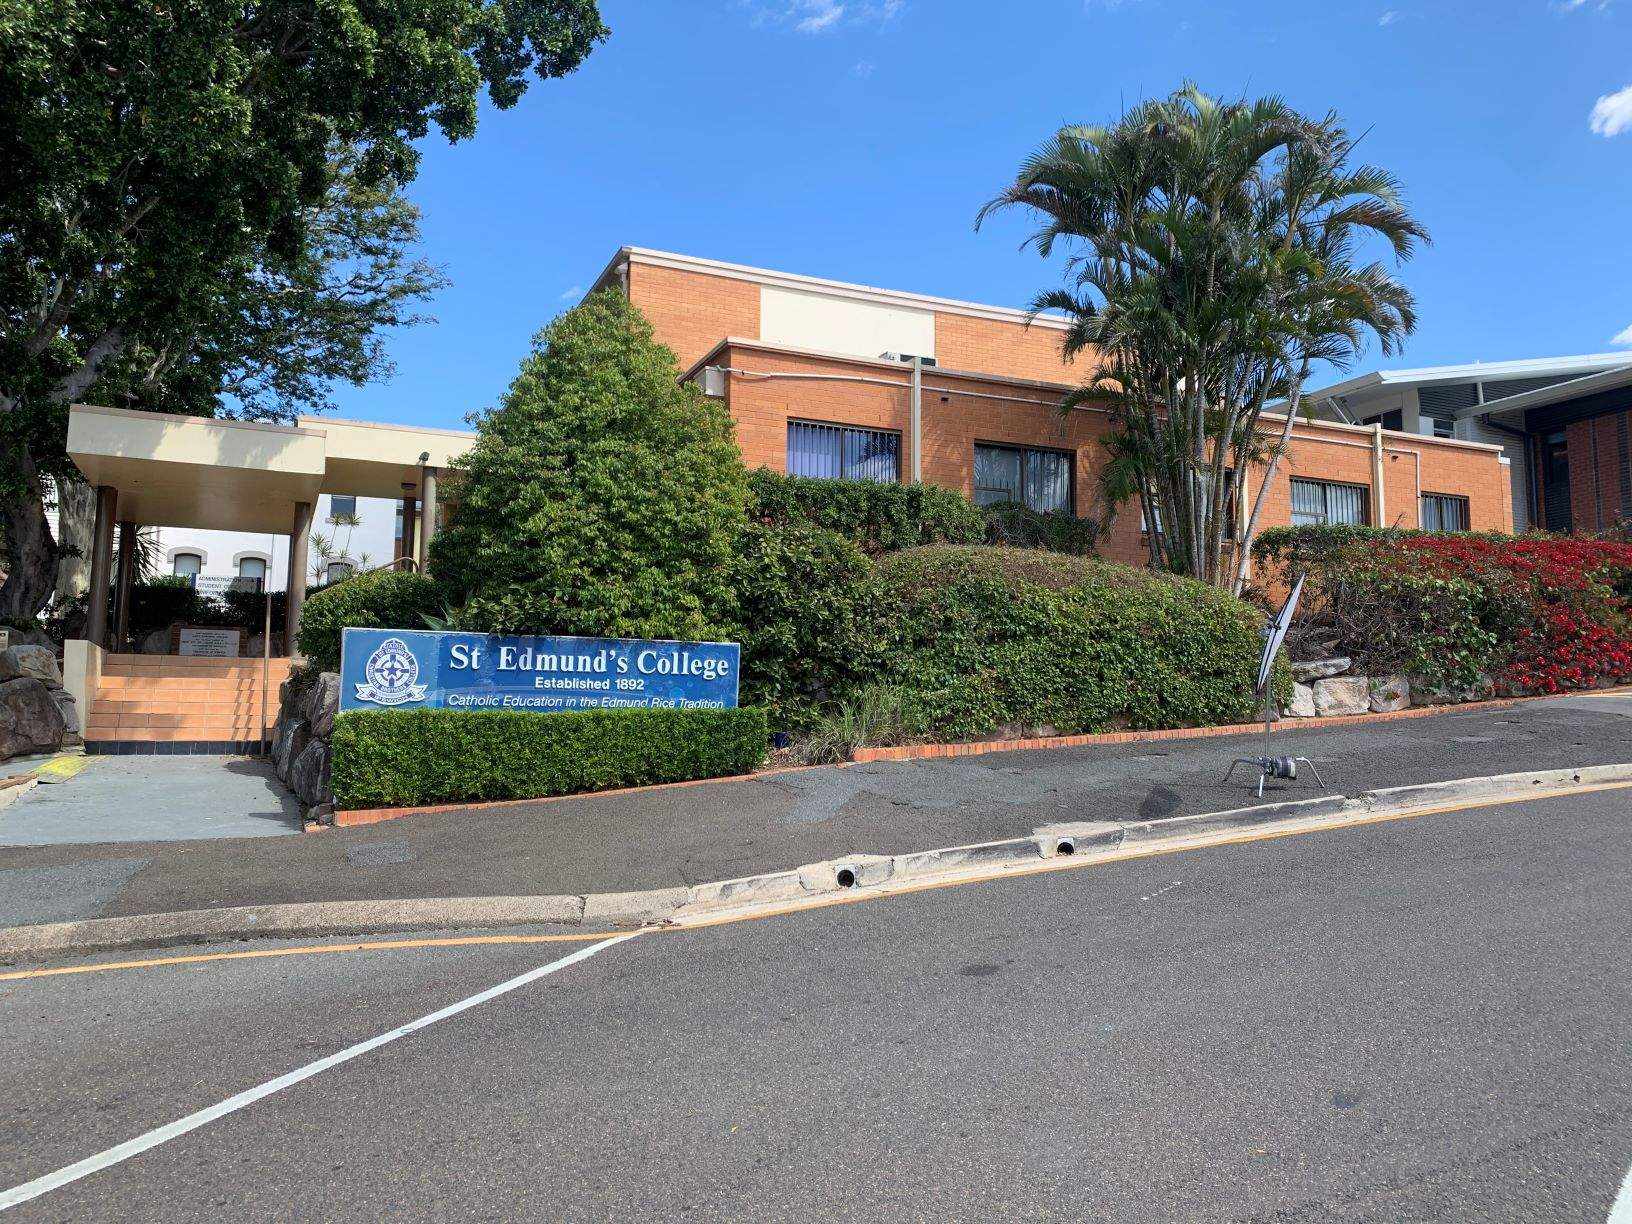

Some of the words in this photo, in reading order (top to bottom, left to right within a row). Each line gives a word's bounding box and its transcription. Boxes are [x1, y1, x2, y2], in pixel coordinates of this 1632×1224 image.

[450, 644, 481, 670] St
[497, 646, 628, 674] Edmund's
[637, 650, 729, 680] College
[535, 677, 610, 690] Established
[614, 679, 645, 691] 1892
[448, 695, 499, 706] Catholic
[503, 695, 563, 707] Education
[566, 696, 577, 707] in
[580, 697, 598, 707] the
[601, 697, 649, 708] Edmund
[650, 697, 676, 708] Rice
[679, 698, 724, 709] Tradition
